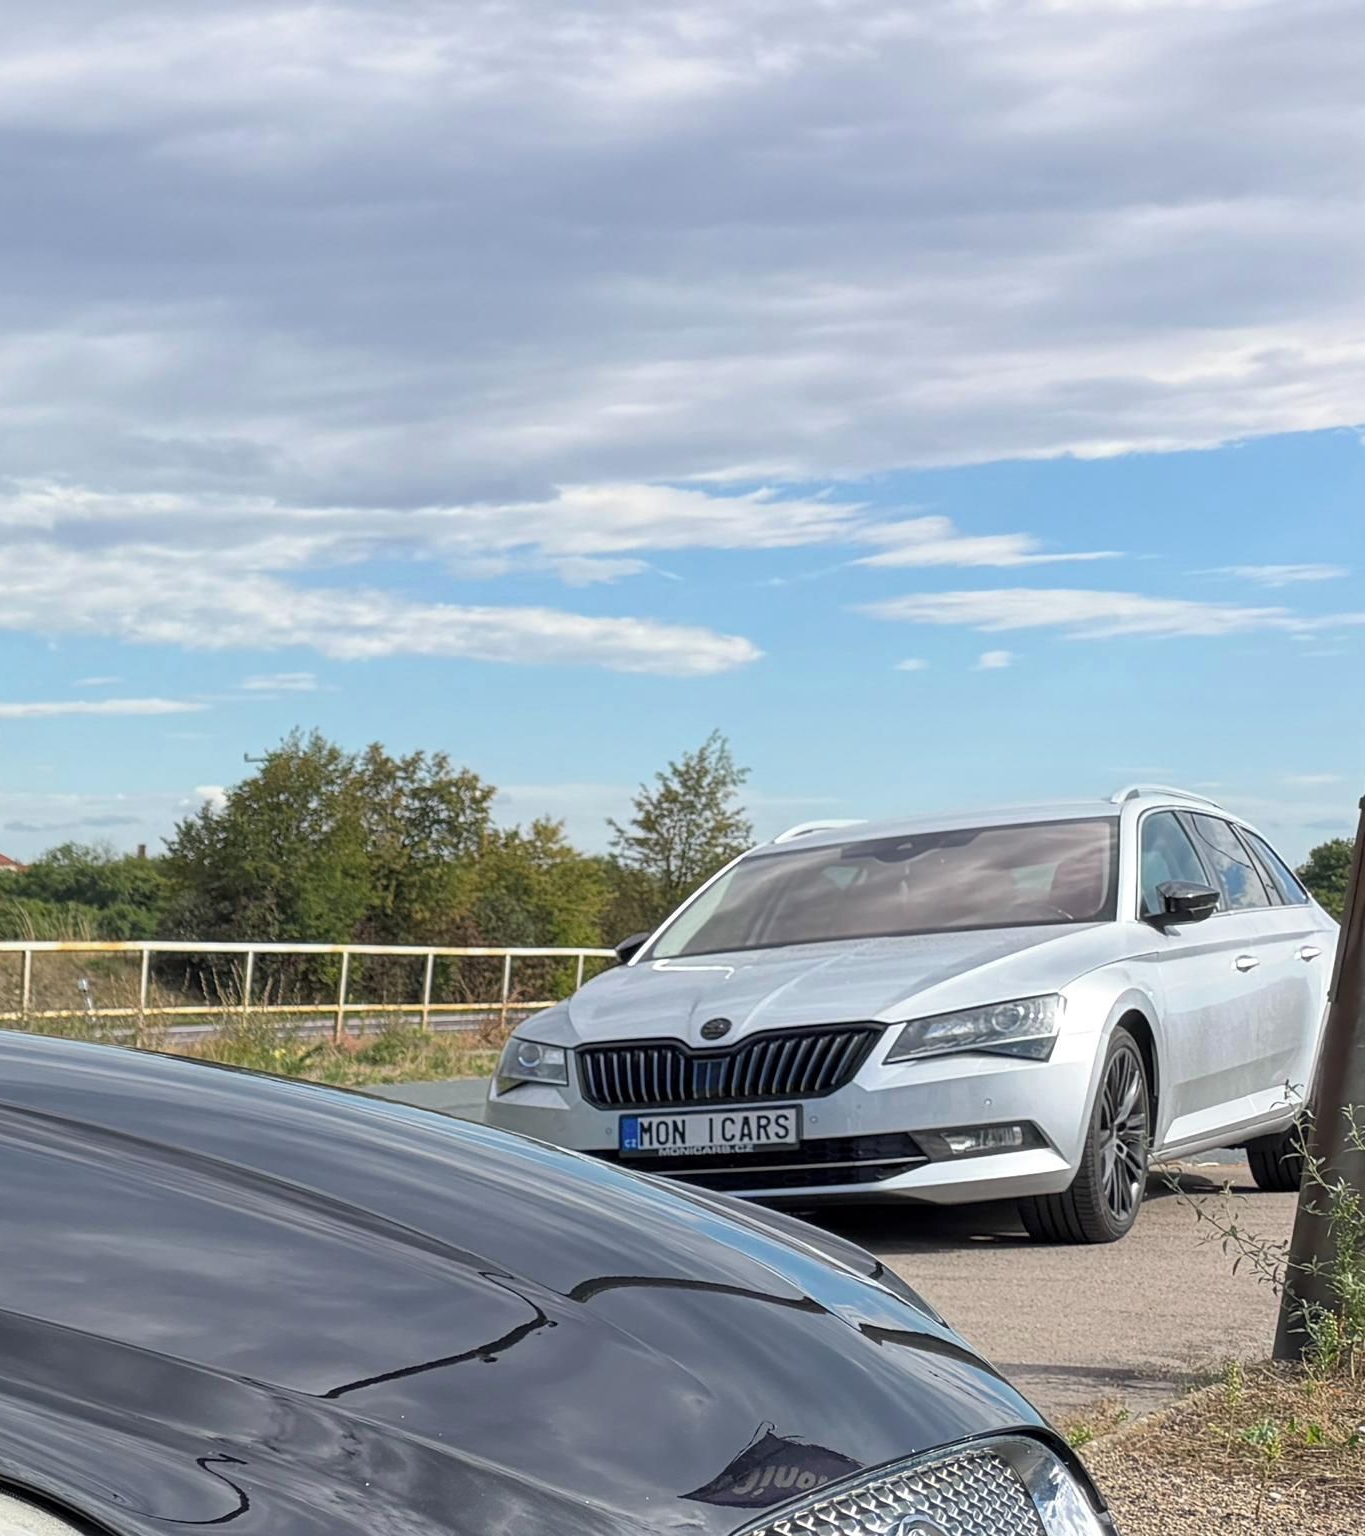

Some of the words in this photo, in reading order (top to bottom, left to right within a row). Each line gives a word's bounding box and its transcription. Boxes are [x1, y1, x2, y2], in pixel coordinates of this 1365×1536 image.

[639, 1119, 686, 1147] MON
[624, 1138, 637, 1148] CZ
[658, 1143, 754, 1157] MONICARS.CZ
